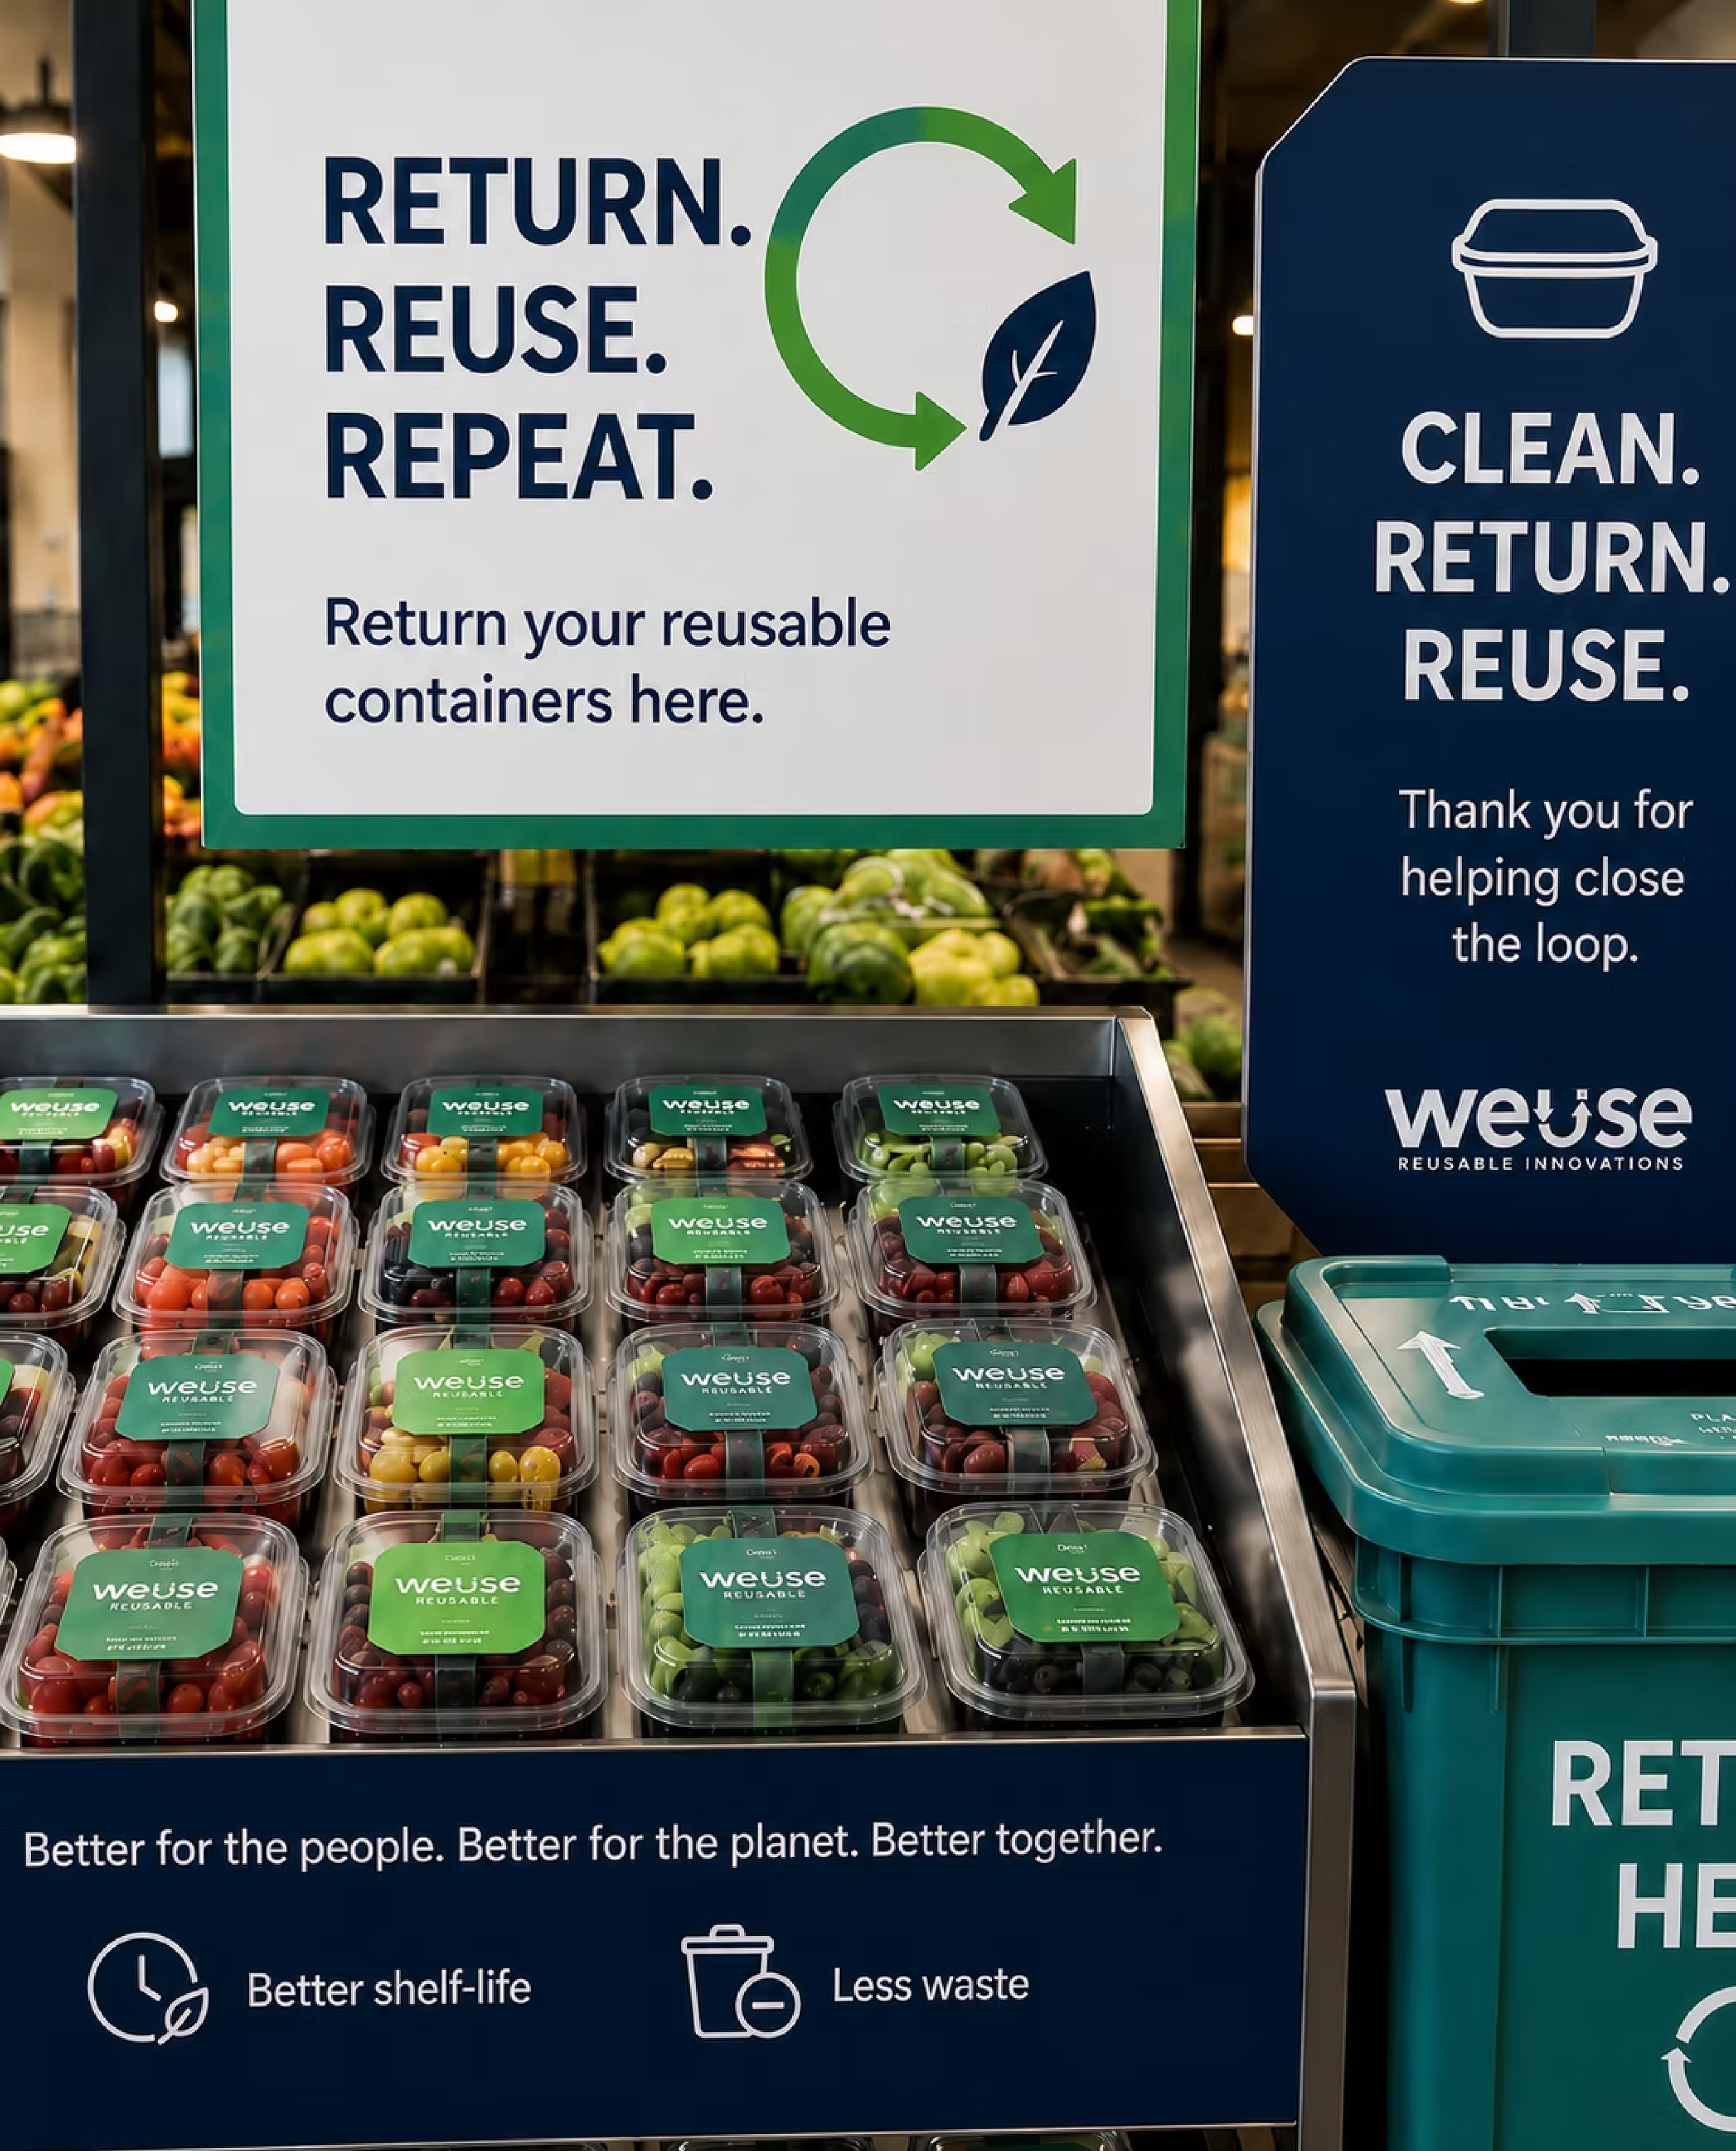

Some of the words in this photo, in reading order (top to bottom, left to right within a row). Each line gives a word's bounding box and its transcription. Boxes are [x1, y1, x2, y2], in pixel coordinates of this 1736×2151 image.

[326, 156, 751, 246] RETURN.
[326, 285, 666, 374] REUSE.
[328, 413, 712, 500] REPEAT.
[1402, 412, 1699, 484] CLEAN.
[1376, 521, 1730, 593] RETURN.
[328, 597, 505, 645] Return
[524, 611, 645, 659] your
[664, 597, 890, 647] reusable
[1405, 629, 1688, 701] REUSE.
[326, 673, 612, 723] containers
[633, 673, 762, 723] here.
[1399, 789, 1530, 828] Thank
[1544, 800, 1619, 840] you
[1634, 789, 1693, 828] for
[1403, 856, 1558, 906] helping
[1576, 856, 1683, 896] close
[1453, 922, 1521, 961] the
[1538, 922, 1637, 972] loop.
[1385, 1088, 1692, 1148] weuse
[1399, 1157, 1512, 1170] REUSABLE
[1526, 1157, 1682, 1170] INNOVATIONS
[190, 1222, 290, 1234] weuse
[428, 1220, 526, 1230] weuse
[668, 1218, 767, 1231] weuse
[917, 1216, 1017, 1229] weuse
[148, 1379, 258, 1395] weuse
[413, 1376, 524, 1390] weuse
[681, 1372, 790, 1388] weuse
[953, 1368, 1065, 1384] weuse
[93, 1583, 218, 1599] weuse
[395, 1577, 520, 1593] weuse
[701, 1572, 826, 1588] weuse
[1015, 1568, 1140, 1583] weuse
[26, 1832, 145, 1866] Better
[156, 1829, 212, 1865] for
[224, 1829, 287, 1865] the
[302, 1826, 444, 1872] people.
[460, 1827, 577, 1861] Better
[590, 1825, 644, 1860] for
[656, 1824, 718, 1859] the
[732, 1823, 858, 1868] planet.
[873, 1822, 985, 1856] Better
[996, 1818, 1162, 1863] together.
[249, 1973, 364, 2007] Better
[374, 1968, 531, 2005] shelf-life
[835, 1968, 911, 2001] Less
[924, 1968, 1029, 2000] waste
